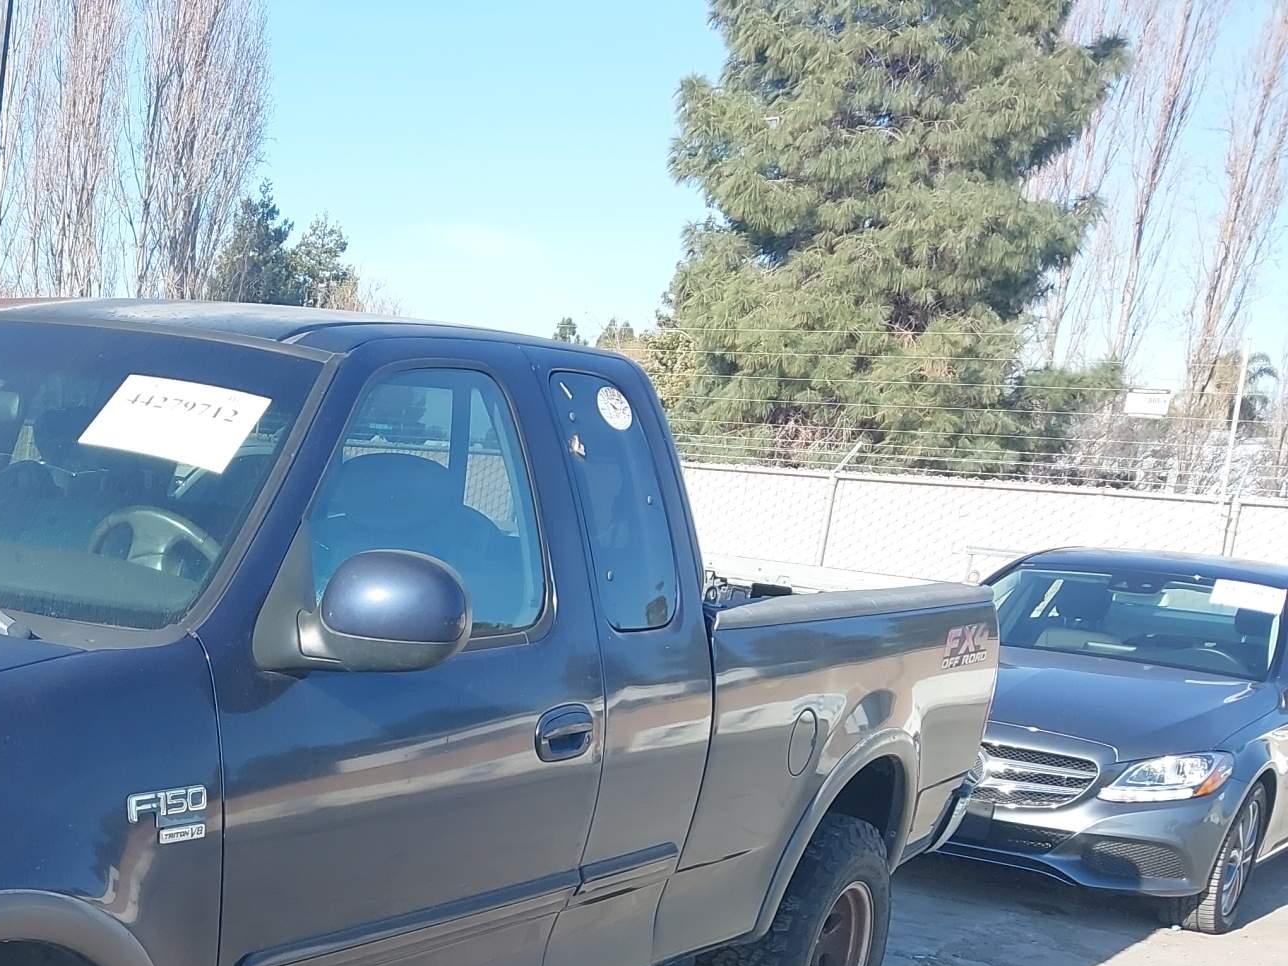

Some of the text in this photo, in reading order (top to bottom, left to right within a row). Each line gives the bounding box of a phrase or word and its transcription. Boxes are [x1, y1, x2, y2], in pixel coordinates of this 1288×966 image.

[126, 393, 239, 423] 44279712
[943, 622, 990, 658] FX4
[941, 651, 988, 669] OFF ROAD
[164, 825, 204, 840] TRITON V8
